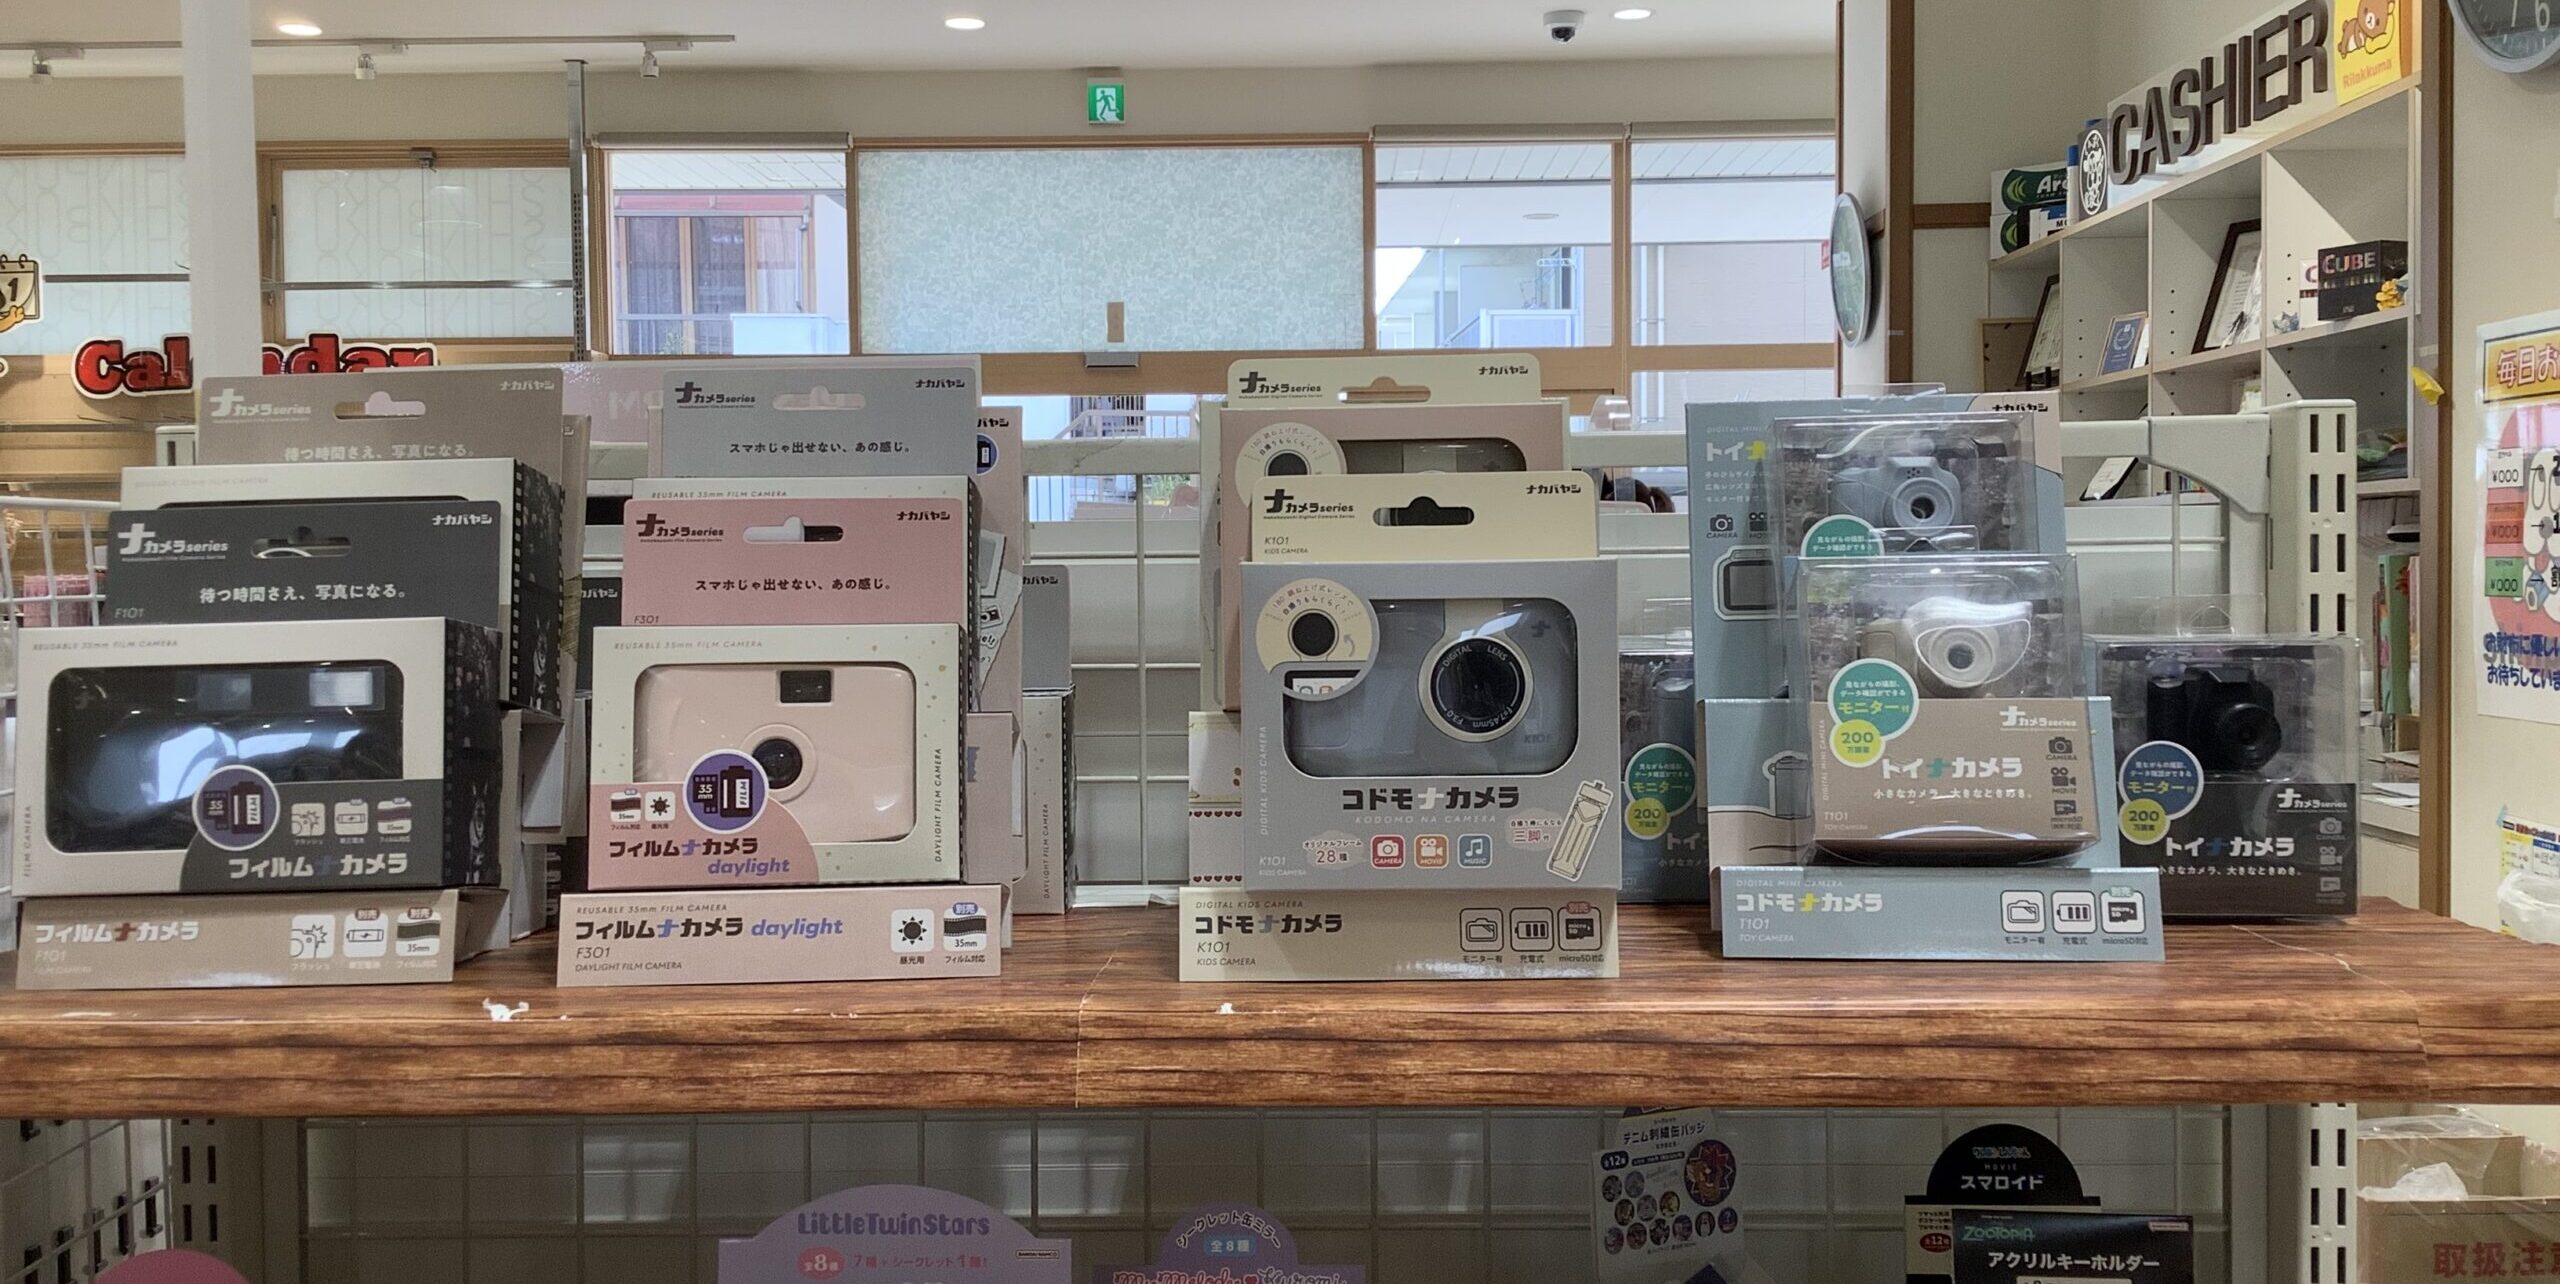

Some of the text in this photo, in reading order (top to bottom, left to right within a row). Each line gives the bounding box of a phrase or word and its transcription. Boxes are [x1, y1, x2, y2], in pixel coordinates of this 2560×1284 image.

[2342, 58, 2393, 89] Rilakkuma
[2109, 0, 2329, 186] CASHIER
[2322, 251, 2377, 274] CUBE
[1478, 366, 1529, 375] ナカバヤシ
[915, 379, 965, 388] ナカバヤシ
[1526, 484, 1582, 494] ナカバヤシ
[1264, 488, 1354, 514] ナカメラseries
[432, 514, 493, 526] ナカバヤシ
[896, 511, 950, 521] ナカバヤシ
[636, 513, 724, 536] ナカメラseries
[117, 523, 229, 554] ナカメラseries
[1264, 536, 1290, 545] K101
[695, 577, 891, 592] スマホじゃ出せない、あの感じ。
[200, 583, 406, 604] 待つ時間さえ、写真になる。
[115, 607, 144, 619] F101
[633, 615, 659, 624] F301
[723, 639, 763, 648] CAMERA
[1442, 644, 1509, 668] DIGITAL LENS
[1841, 731, 1874, 745] 200
[1258, 726, 1267, 768] CAMERA
[1882, 756, 2023, 780] トイナカメラ
[698, 784, 713, 794] 35
[739, 780, 748, 806] FILM
[1342, 786, 1520, 811] コドモナカメラ
[1634, 808, 1661, 819] 200
[1823, 811, 1848, 821] T101
[2128, 810, 2159, 822] 200
[934, 815, 943, 862] DAYLIGHT
[609, 837, 758, 858] フィルムナカメラ
[2166, 836, 2295, 857] トイナカメラ
[228, 852, 409, 879] フィルムナカメラ
[707, 858, 790, 877] daylight
[1258, 856, 1287, 866] K101
[1373, 857, 1403, 865] CAMERA
[576, 905, 624, 914] REUSABLE
[628, 905, 657, 913] 35mm
[687, 904, 728, 912] CAMERA
[1736, 893, 1883, 913] コドモナカメラ
[576, 917, 843, 940] フィルムナカメラ daylight
[1195, 914, 1343, 934] コドモナカメラ
[1739, 918, 1770, 929] T101
[35, 920, 200, 944] フィルムナカメラ
[407, 944, 430, 952] 35mm
[954, 939, 978, 948] 35mm
[1197, 941, 1231, 953] K101
[576, 946, 611, 959] F301
[575, 962, 682, 972] DAYLIGHT FILM CAMERA
[1219, 958, 1256, 966] CAMERA
[1960, 1174, 2044, 1190] スマロイド
[1175, 1209, 1282, 1249] シークレット缶ミラー
[1988, 1251, 2160, 1272] アクリルキーホルダー
